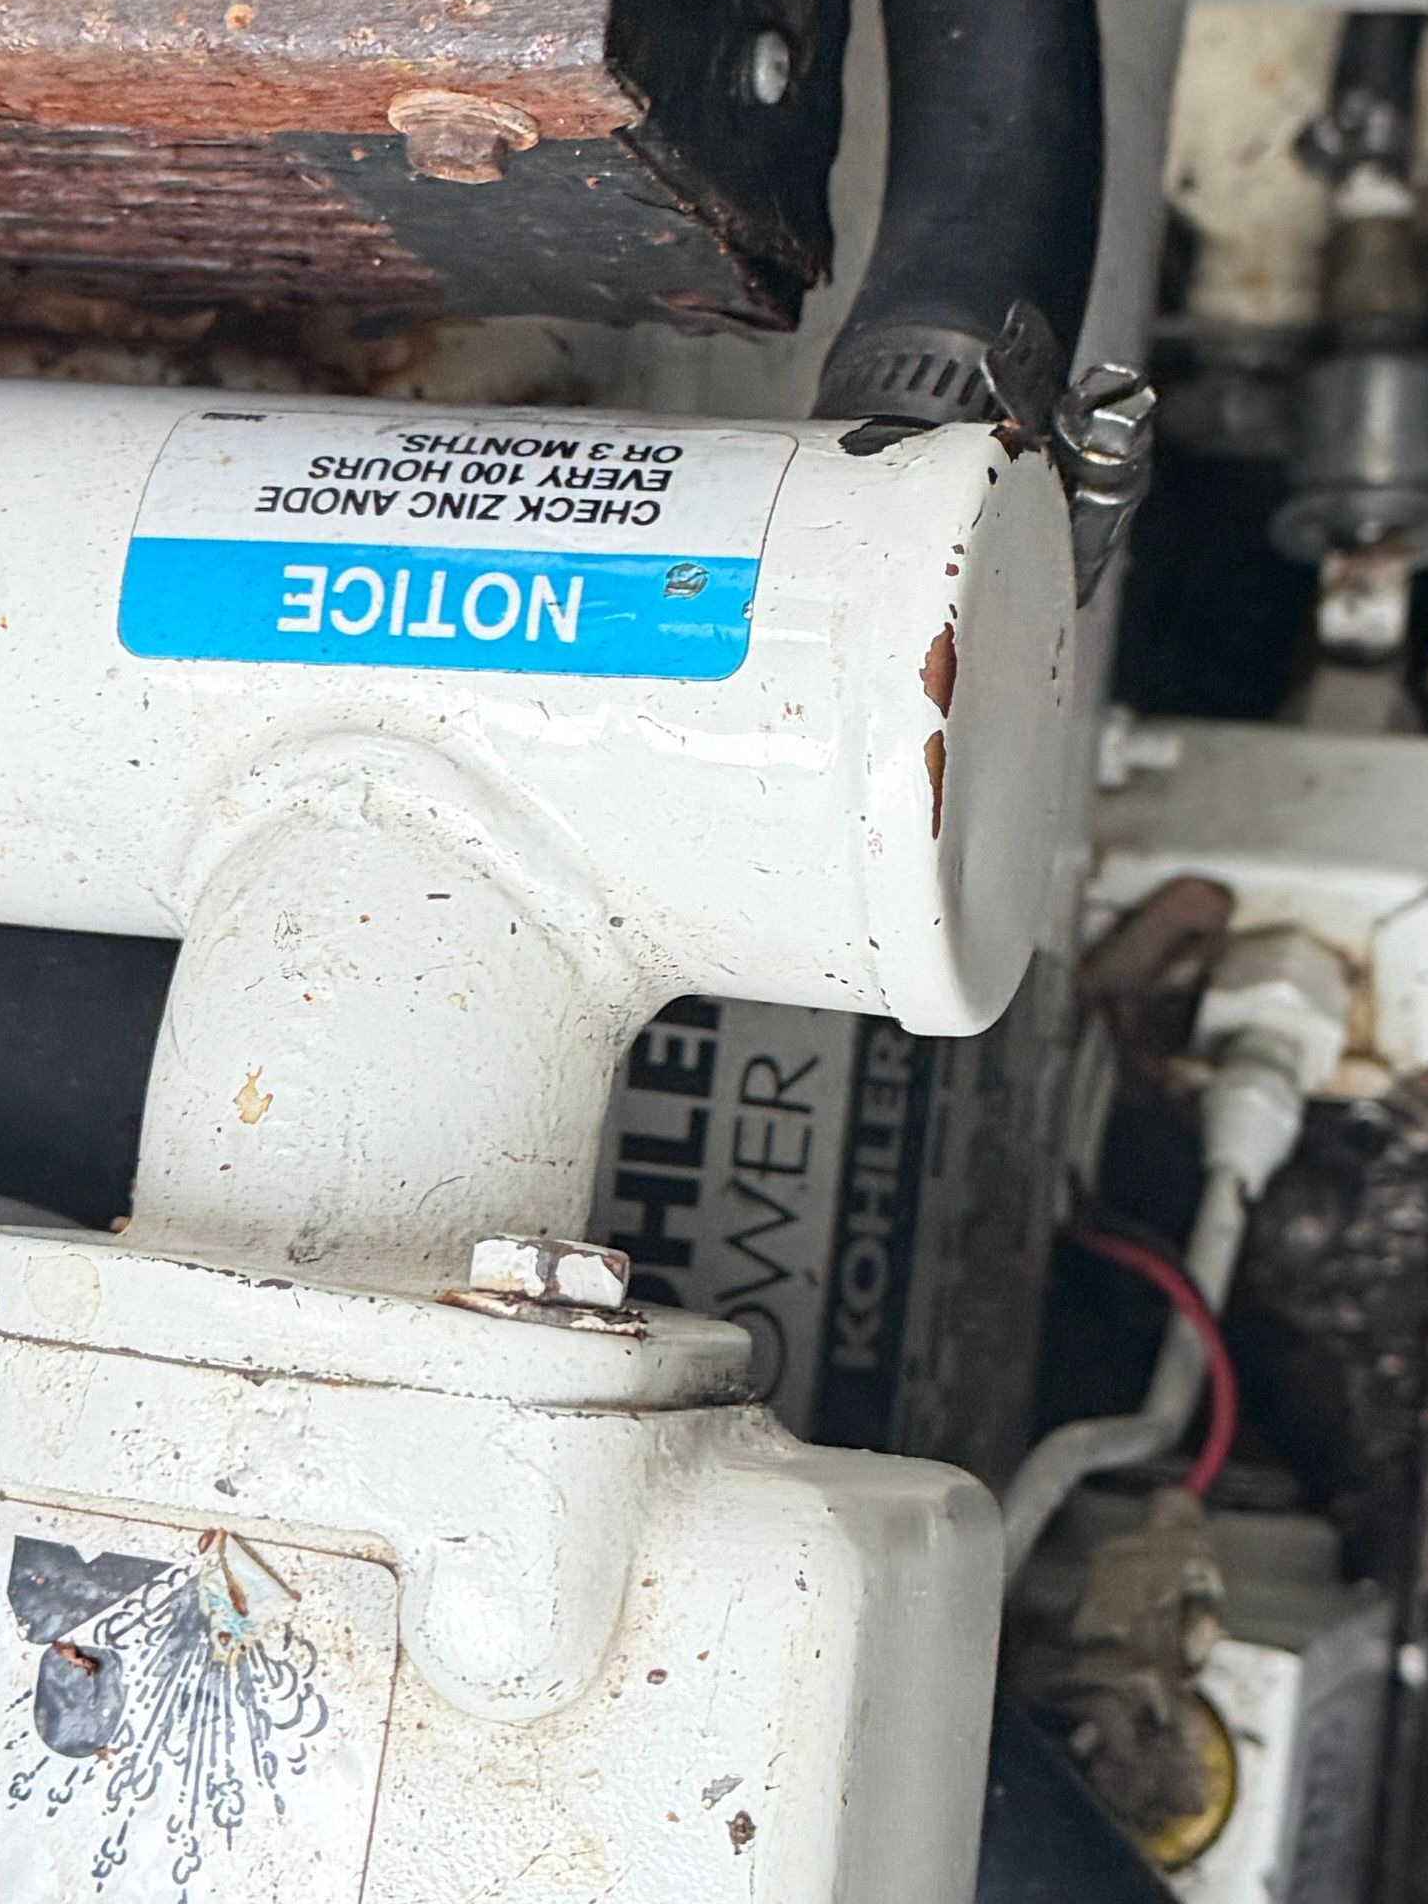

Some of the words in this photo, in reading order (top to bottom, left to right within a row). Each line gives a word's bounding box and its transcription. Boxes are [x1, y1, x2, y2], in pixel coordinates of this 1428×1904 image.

[395, 433, 580, 458] MONTHS.
[588, 442, 613, 461] 3
[623, 443, 683, 463] OR
[308, 456, 452, 482] HOURS
[462, 461, 523, 484] 100
[537, 465, 673, 492] EVERY
[256, 485, 401, 516] ANODE
[410, 490, 506, 520] ZINC
[512, 495, 661, 526] CHECK
[277, 565, 584, 642] NOTICE
[831, 1024, 913, 1371] KOHLER
[713, 1052, 820, 1402] OWER
